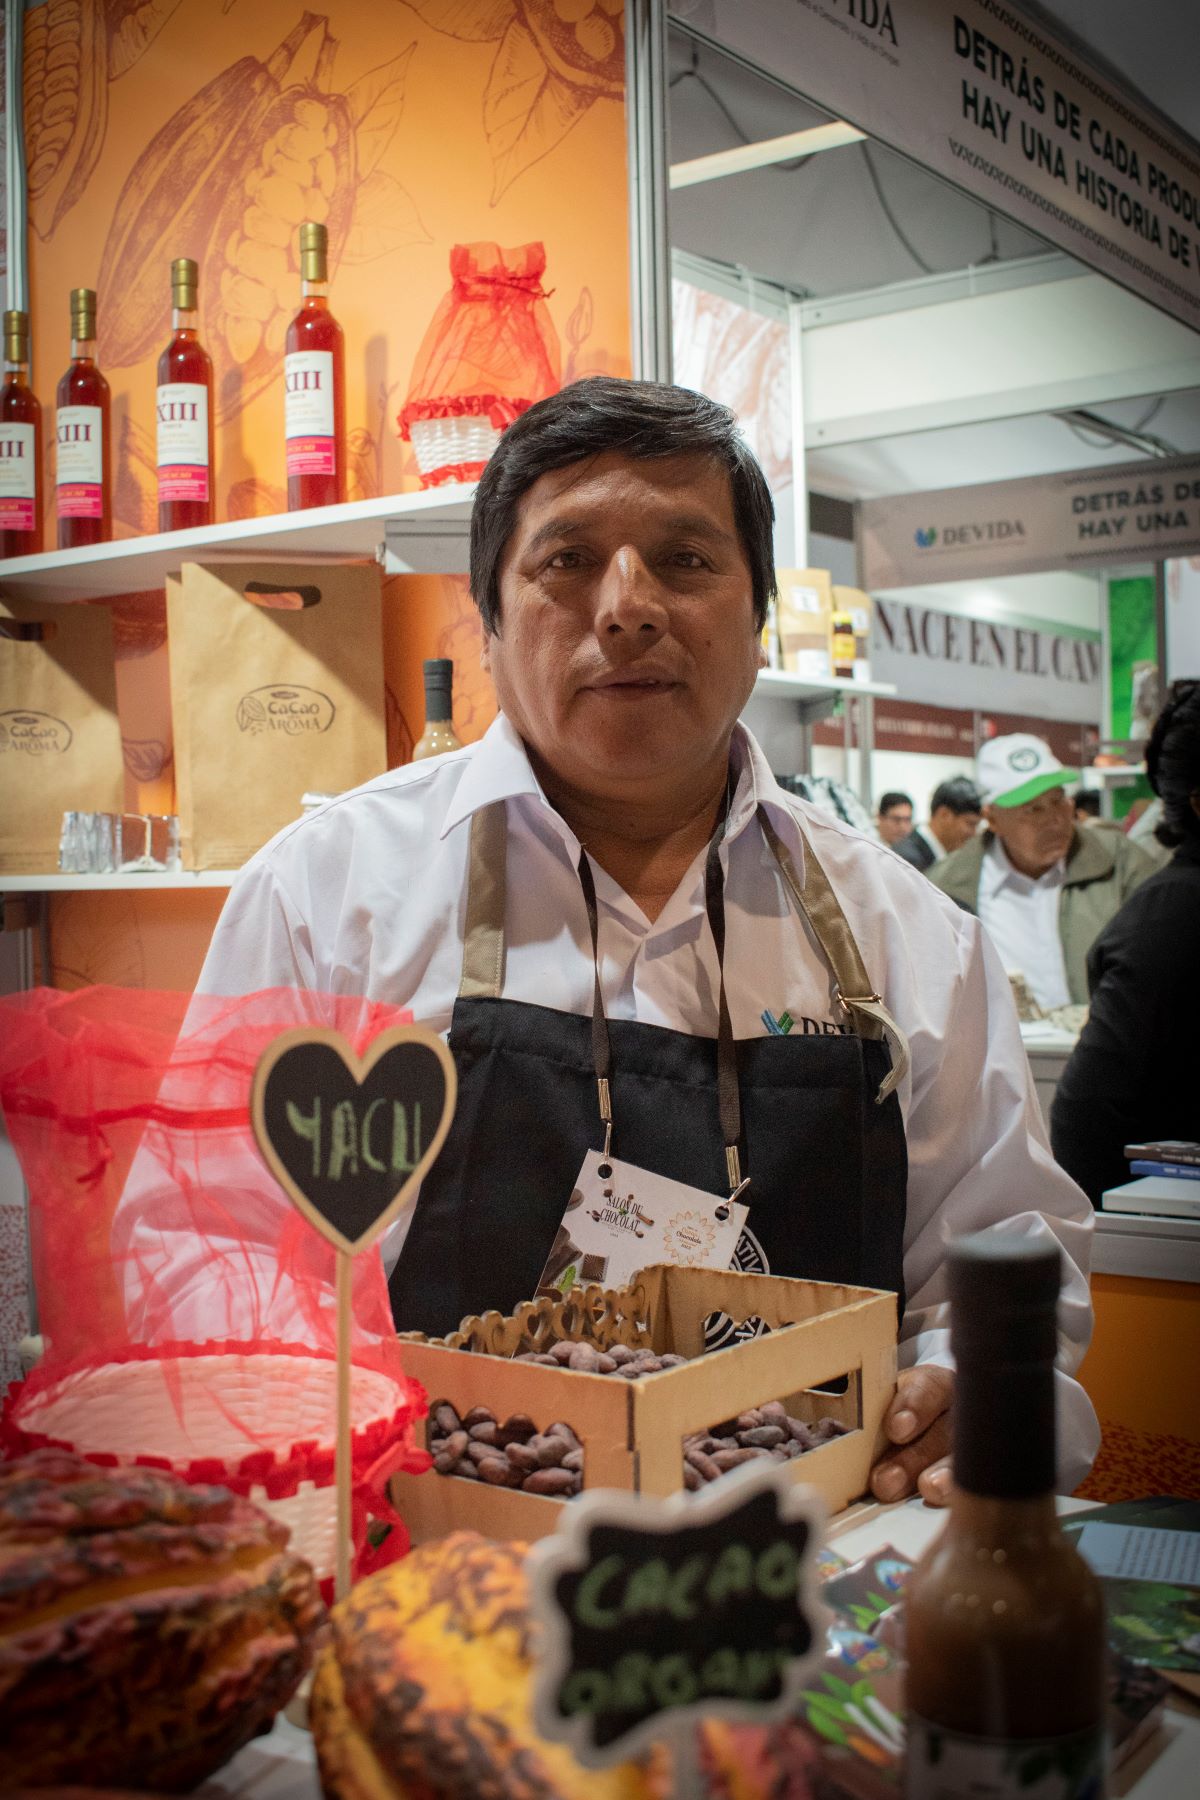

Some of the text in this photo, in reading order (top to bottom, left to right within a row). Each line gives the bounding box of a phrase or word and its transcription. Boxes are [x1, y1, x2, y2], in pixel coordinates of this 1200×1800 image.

[834, 0, 899, 48] IDA
[953, 14, 1046, 115] DETRÁS
[1053, 89, 1081, 142] DE
[1088, 118, 1141, 187] CADA
[961, 78, 1012, 144] HAY
[1020, 119, 1069, 186] UNA
[1075, 159, 1163, 249] HISTORIA
[1167, 225, 1191, 269] DE
[1072, 483, 1165, 515] DETRÁS
[1077, 509, 1189, 538] HAY UNA
[942, 518, 1026, 546] DEVIDA
[875, 598, 964, 664] NACE
[968, 617, 1008, 669] EN
[1013, 627, 1049, 677] EL
[285, 1095, 422, 1182] YACU
[599, 1207, 641, 1232] CHOCOLAT
[576, 1543, 800, 1628] CACAO
